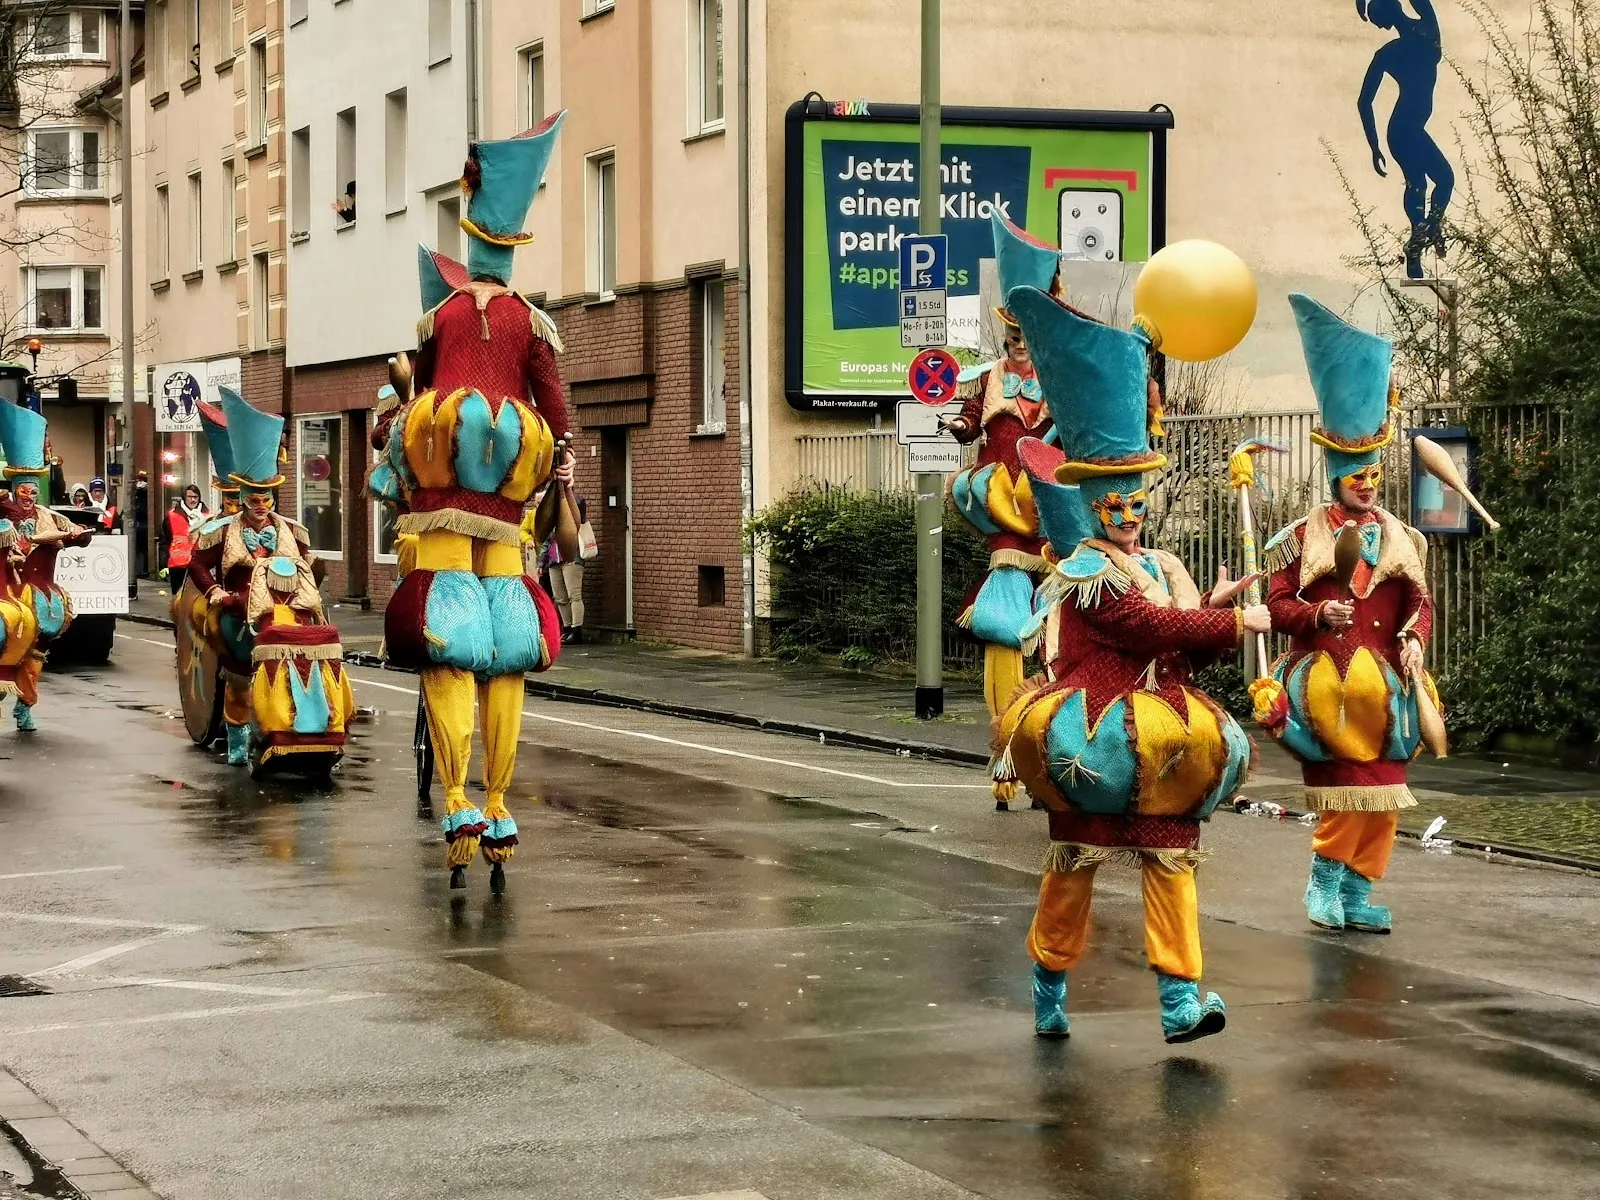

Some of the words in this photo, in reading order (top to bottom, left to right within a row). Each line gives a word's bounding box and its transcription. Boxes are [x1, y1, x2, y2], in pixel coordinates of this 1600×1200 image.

[839, 156, 914, 182] Jetzt
[911, 244, 936, 287] P
[903, 321, 922, 331] Mo-Fr
[903, 334, 912, 343] Sa
[840, 361, 888, 374] Europas
[891, 362, 909, 373] Nr.
[812, 400, 878, 408] Plakat-verkauft.de
[910, 452, 959, 464] Rosenmontag
